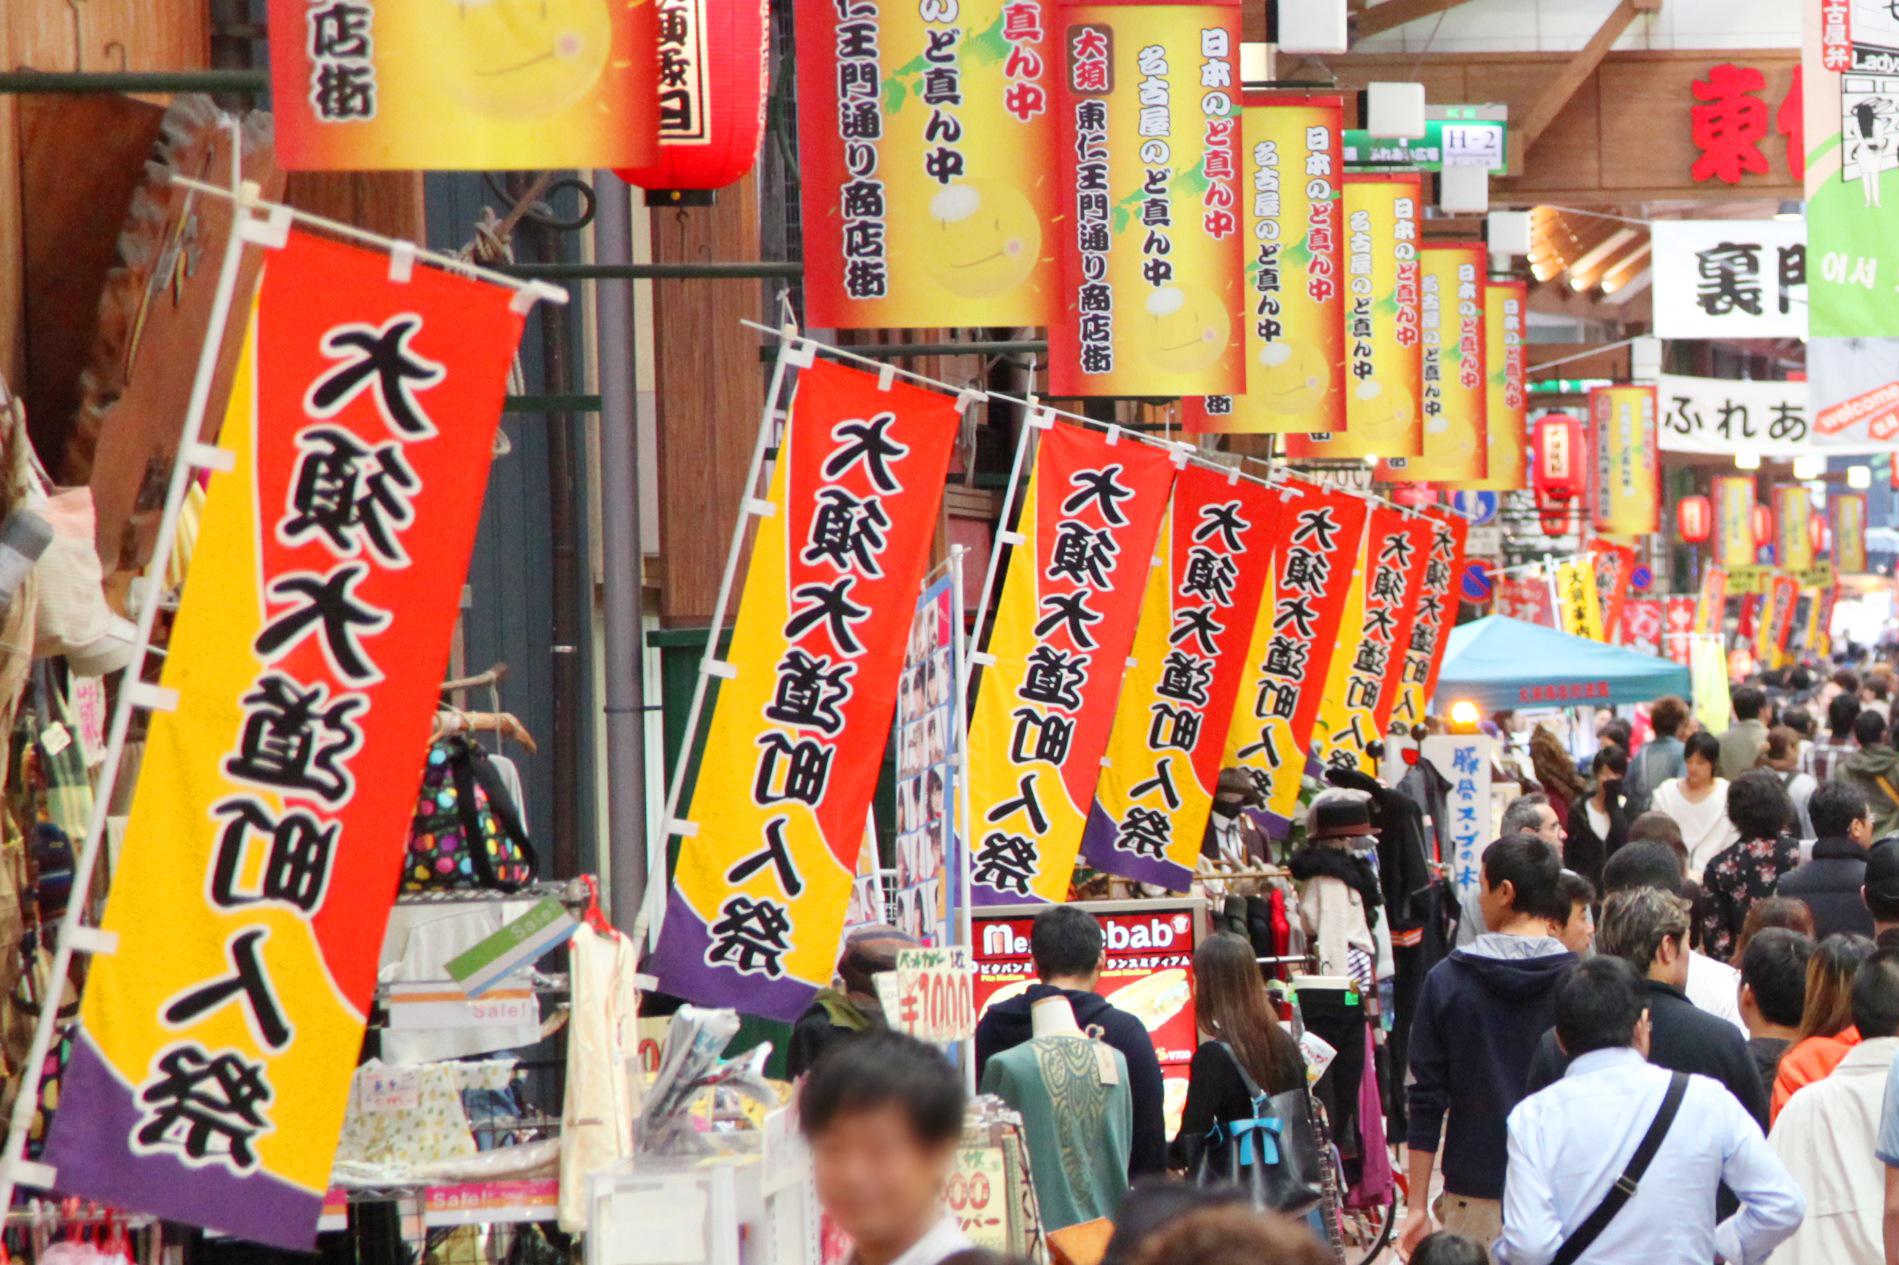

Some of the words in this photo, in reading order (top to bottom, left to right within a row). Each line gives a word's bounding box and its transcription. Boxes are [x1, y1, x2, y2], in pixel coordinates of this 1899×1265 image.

[1072, 27, 1109, 93] 大須
[1200, 27, 1235, 240] 日本のど真ん中
[1076, 100, 1113, 374] 東仁王門通り商店街
[1137, 44, 1173, 288] 名古屋のど真ん中
[1253, 140, 1283, 343] 名古屋のど真ん中
[1305, 126, 1334, 302] 日本のど真ん中
[1350, 210, 1374, 380] 名古屋のど真ん中
[1393, 197, 1418, 347] 日本のど真ん中
[1458, 263, 1479, 389] 日本のど真ん中
[1820, 252, 1877, 289] 어서
